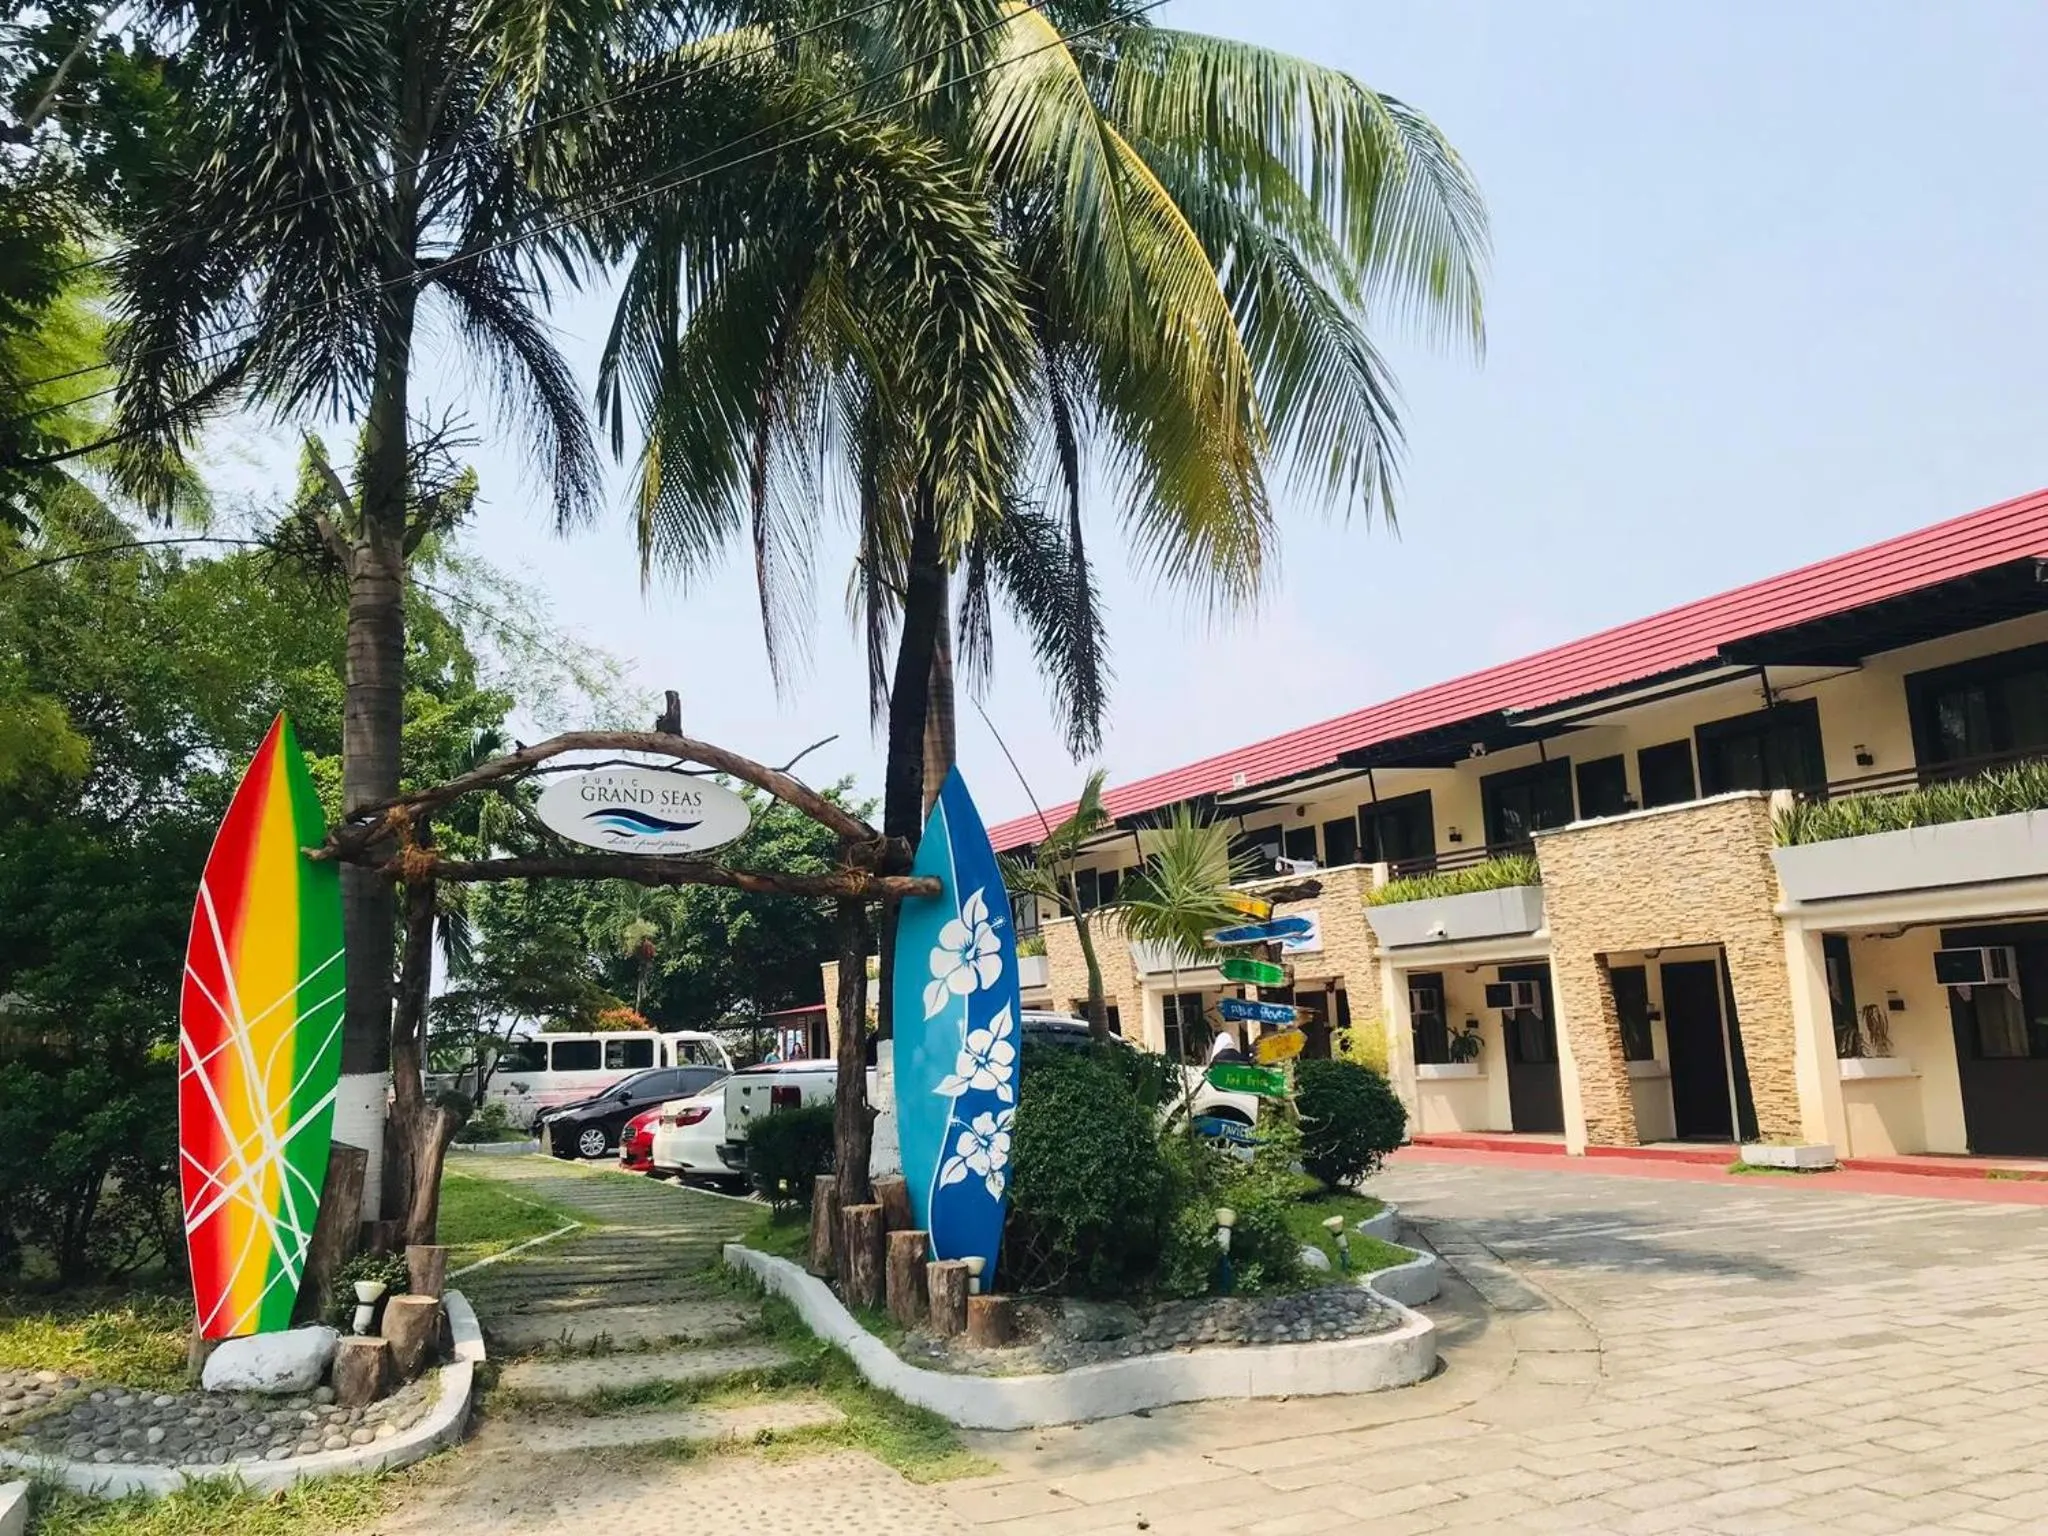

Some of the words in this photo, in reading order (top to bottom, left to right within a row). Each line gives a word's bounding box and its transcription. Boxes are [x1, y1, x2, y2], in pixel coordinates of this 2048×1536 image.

[582, 776, 639, 787] SUBIC
[581, 786, 655, 804] GRAND
[660, 790, 702, 806] SEAS
